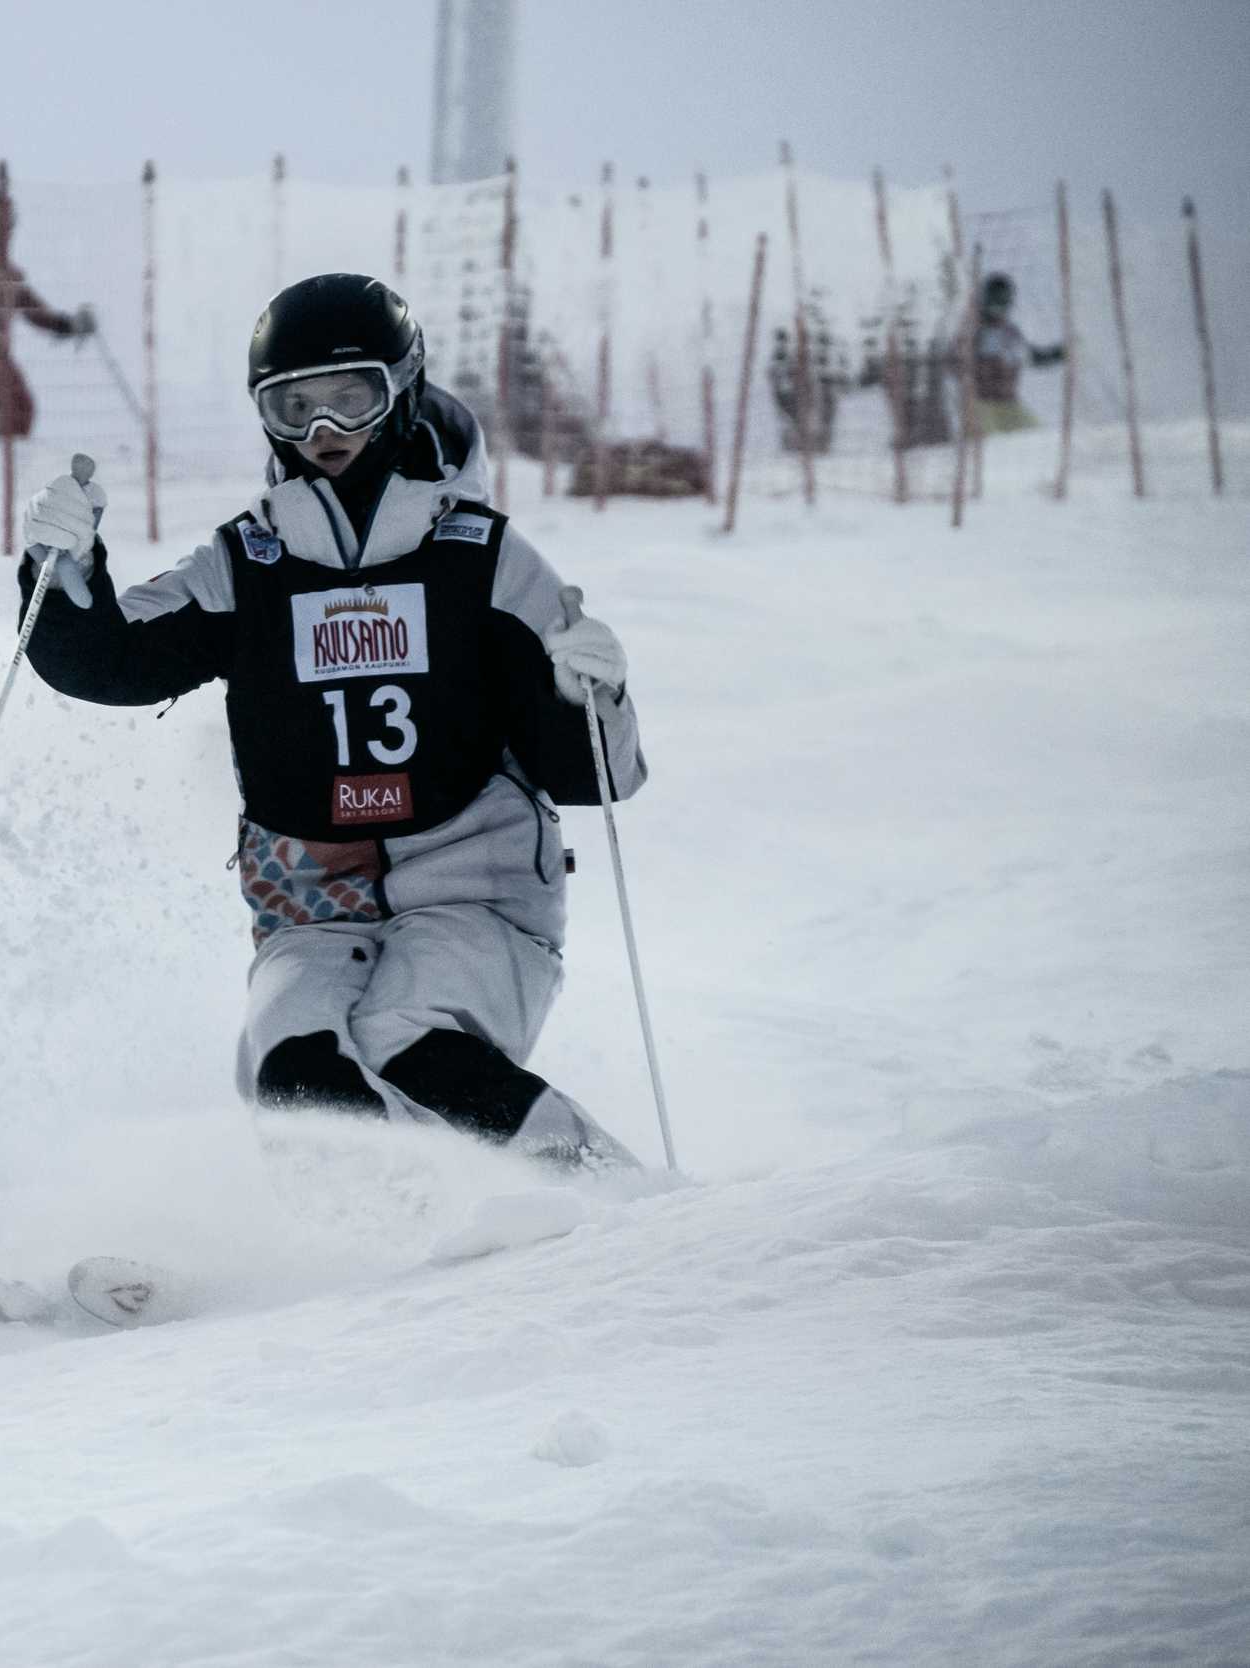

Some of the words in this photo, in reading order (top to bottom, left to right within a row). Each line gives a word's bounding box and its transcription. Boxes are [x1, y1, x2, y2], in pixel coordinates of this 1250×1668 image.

[313, 617, 409, 668] KUUSAMO
[323, 684, 418, 766] 13
[339, 784, 402, 809] RUKA!
